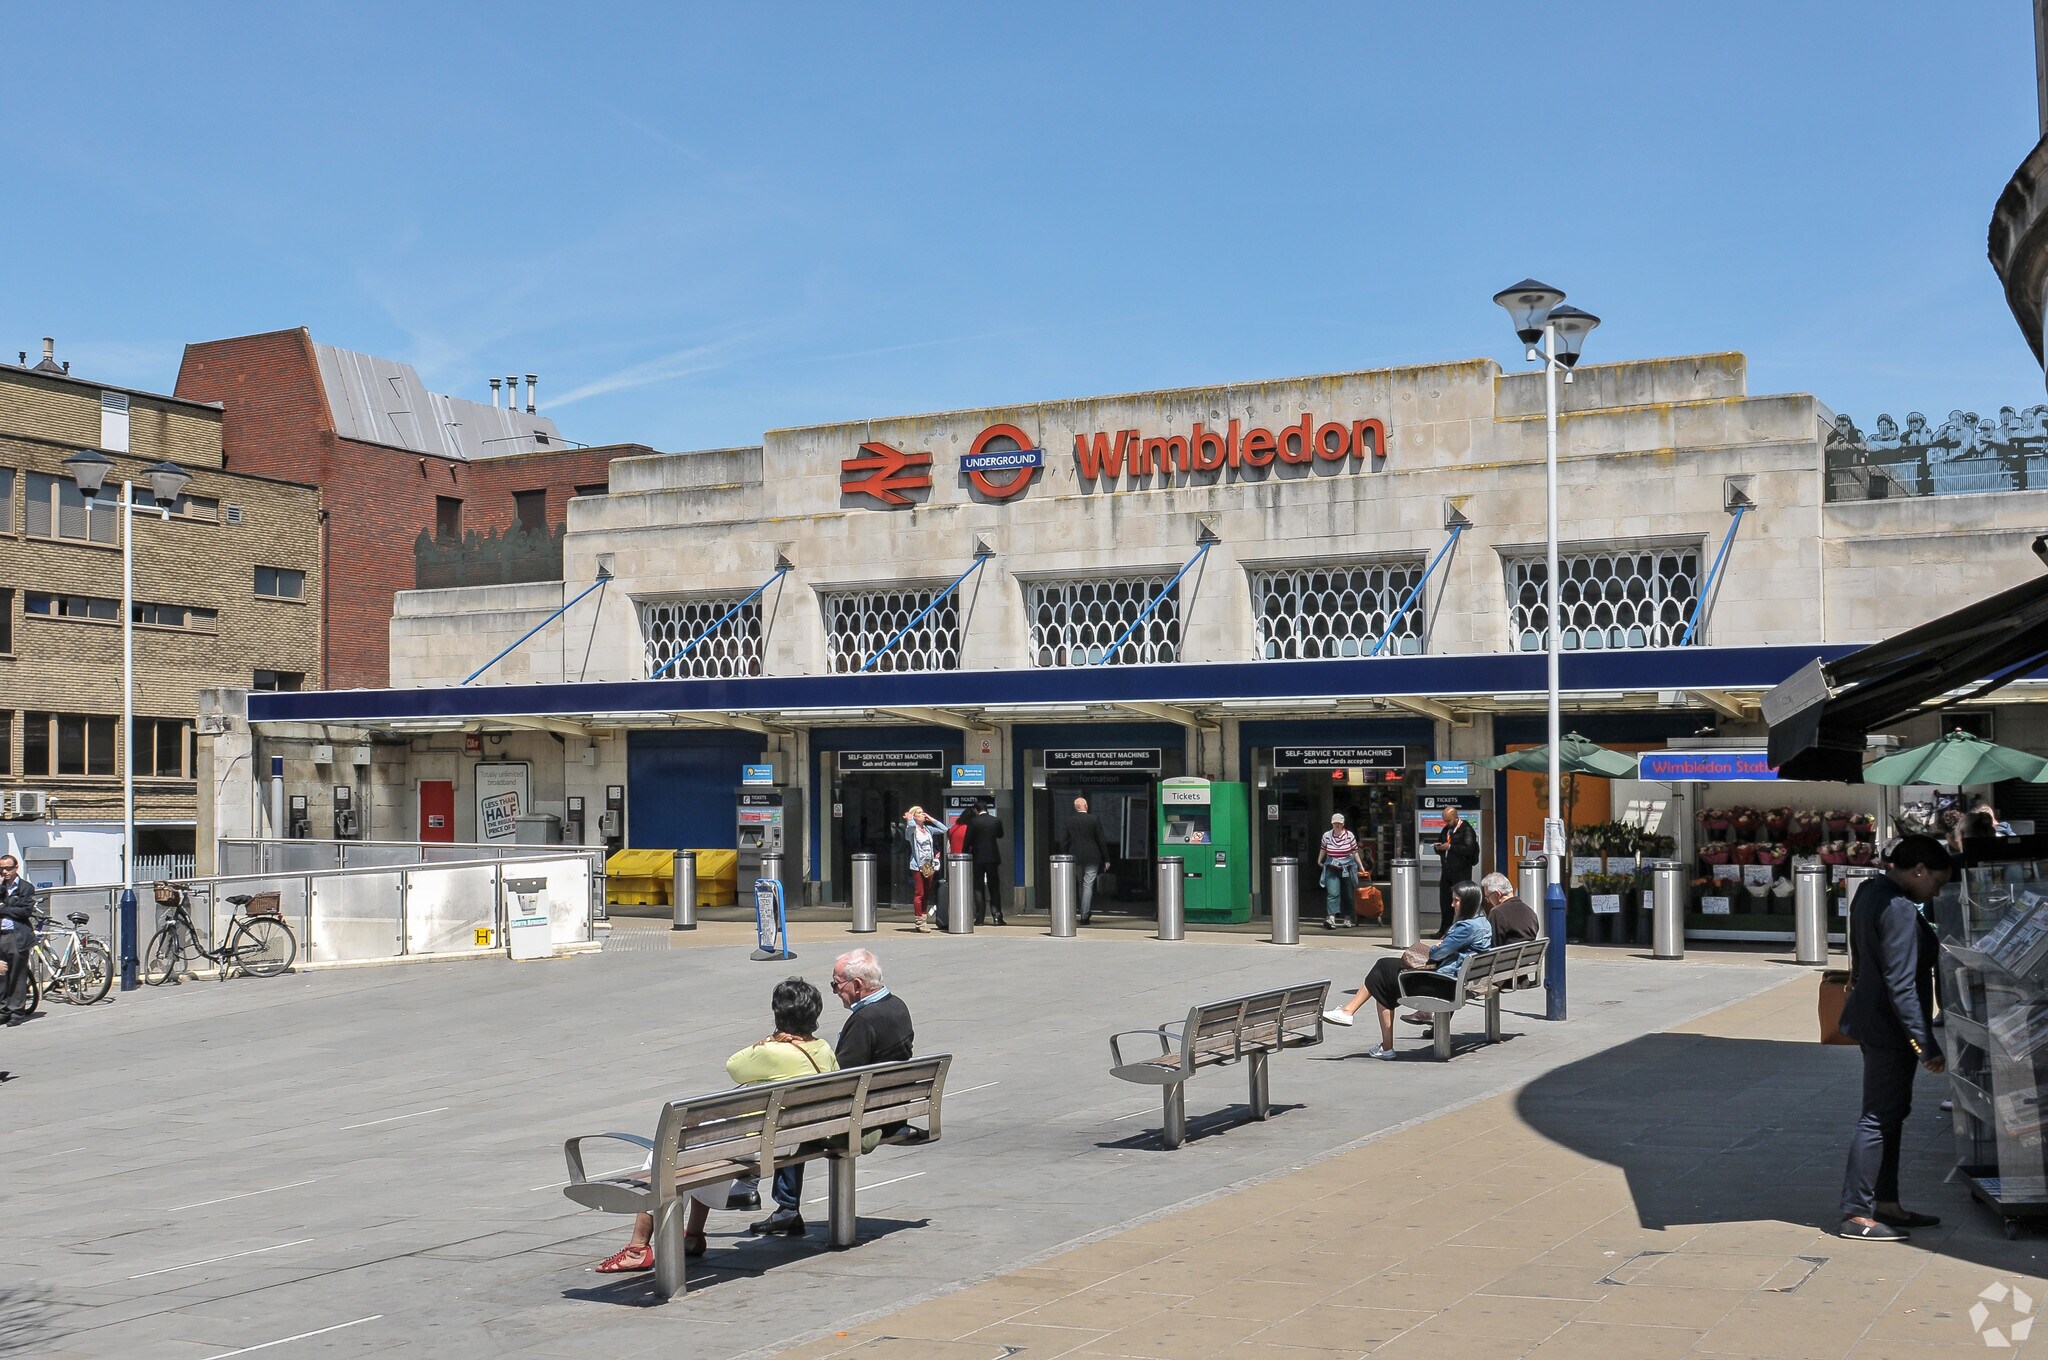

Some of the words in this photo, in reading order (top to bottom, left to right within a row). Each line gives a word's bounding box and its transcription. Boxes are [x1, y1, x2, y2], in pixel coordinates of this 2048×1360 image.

[1074, 412, 1387, 480] Wimbledon
[965, 454, 1036, 468] UNDERGROUND
[1356, 749, 1392, 757] MACHINES
[1652, 759, 1732, 773] Wimbledon
[481, 770, 497, 778] Totally
[485, 800, 498, 808] LESS
[499, 796, 516, 804] THAN
[1172, 792, 1200, 800] Tickets
[486, 804, 517, 822] HALF
[488, 826, 503, 834] PRICE
[476, 930, 488, 944] H
